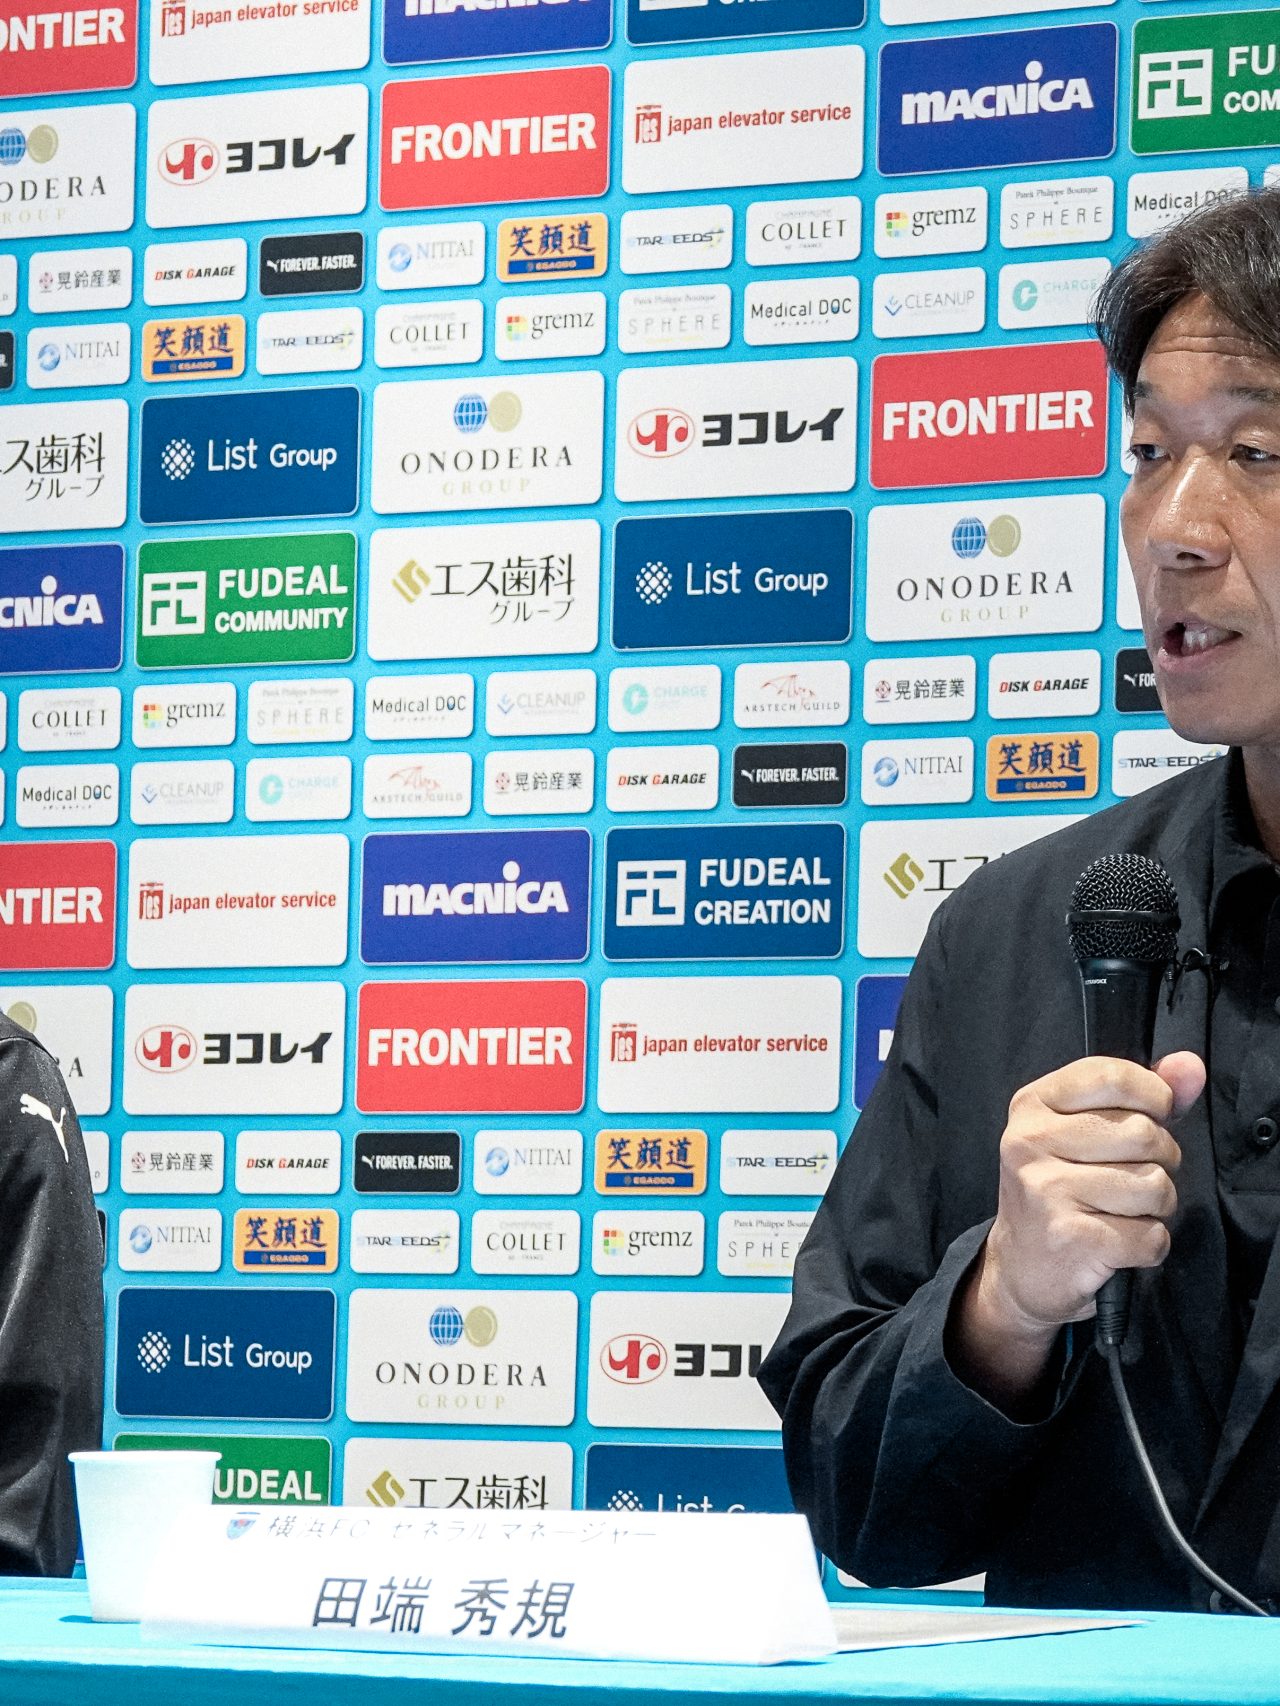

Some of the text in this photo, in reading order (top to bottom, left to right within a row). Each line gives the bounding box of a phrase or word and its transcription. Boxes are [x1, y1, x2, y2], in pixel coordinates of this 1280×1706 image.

[191, 0, 358, 29] japan elevator service
[668, 104, 851, 136] japan elevator service
[390, 112, 597, 164] FRONTIER
[226, 133, 355, 174] ヨコレイ
[1134, 193, 1199, 212] Medical
[912, 207, 976, 236] gremz
[1010, 206, 1104, 230] SPHERE
[510, 221, 596, 256] 笑顔道
[762, 219, 847, 242] COLLET
[416, 239, 474, 260] NITTAI
[154, 265, 236, 281] DISK GARAGE
[279, 253, 357, 272] FOREVER. FASTER.
[1043, 278, 1098, 294] CHARGE
[751, 297, 852, 319] Medical DOC
[905, 290, 975, 311] CLEANUP
[390, 322, 470, 344] COLLET
[531, 312, 594, 340] gremz
[628, 314, 721, 336] SPHERE
[65, 340, 120, 360] NITTAI
[154, 322, 234, 357] 笑顔道
[702, 407, 845, 447] ヨコレイ
[883, 390, 1094, 441] FRONTIER
[0, 432, 106, 475] ス歯科
[207, 438, 338, 473] List Group
[401, 445, 573, 475] ONODERA
[25, 473, 106, 501] グループ
[442, 477, 532, 497] GROUP
[218, 564, 349, 599] FUDEAL
[430, 553, 577, 597] エス歯科
[686, 561, 829, 597] List Group
[896, 570, 1074, 602] ONODERA
[214, 606, 349, 634] COMMUNITY
[489, 597, 576, 625] グループ
[940, 604, 1031, 623] GROUP
[895, 678, 965, 701] 晃鈴産業
[999, 678, 1090, 692] DISK GARAGE
[372, 695, 467, 714] Medical DOC
[517, 691, 586, 709] CLEANUP
[803, 702, 841, 712] GUILD
[32, 708, 107, 729] COLLET
[166, 703, 226, 728] gremz
[257, 707, 344, 726] SPHERE
[904, 755, 964, 775] NITTAI
[999, 739, 1087, 775] 笑顔道
[514, 772, 583, 792] 晃鈴産業
[618, 773, 707, 786] DISK GARAGE
[756, 767, 840, 783] FOREVER. FASTER.
[22, 784, 112, 802] Medical DOC
[160, 781, 224, 797] CLEANUP
[699, 856, 832, 887] FUDEAL
[0, 885, 103, 924] NTIER
[169, 892, 337, 914] japan elevator service
[694, 897, 832, 925] CREATION
[203, 1031, 333, 1065] ヨコレイ
[368, 1026, 573, 1068] FRONTIER
[642, 1034, 828, 1055] japan elevator service
[149, 1152, 214, 1172] 晃鈴産業
[246, 1158, 330, 1169] DISK GARAGE
[375, 1154, 454, 1170] FOREVER. FASTER.
[513, 1148, 572, 1166] NITTAI
[607, 1136, 695, 1170] 笑顔道
[156, 1225, 212, 1244] NITTAI
[245, 1215, 328, 1248] 笑顔道
[486, 1231, 567, 1252] COLLET
[627, 1229, 693, 1256] gremz
[183, 1334, 313, 1375] List Group
[375, 1361, 547, 1387] ONODERA
[417, 1393, 506, 1409] GROUP
[213, 1468, 322, 1501] UDEAL
[311, 1575, 576, 1640] 田端 秀規
